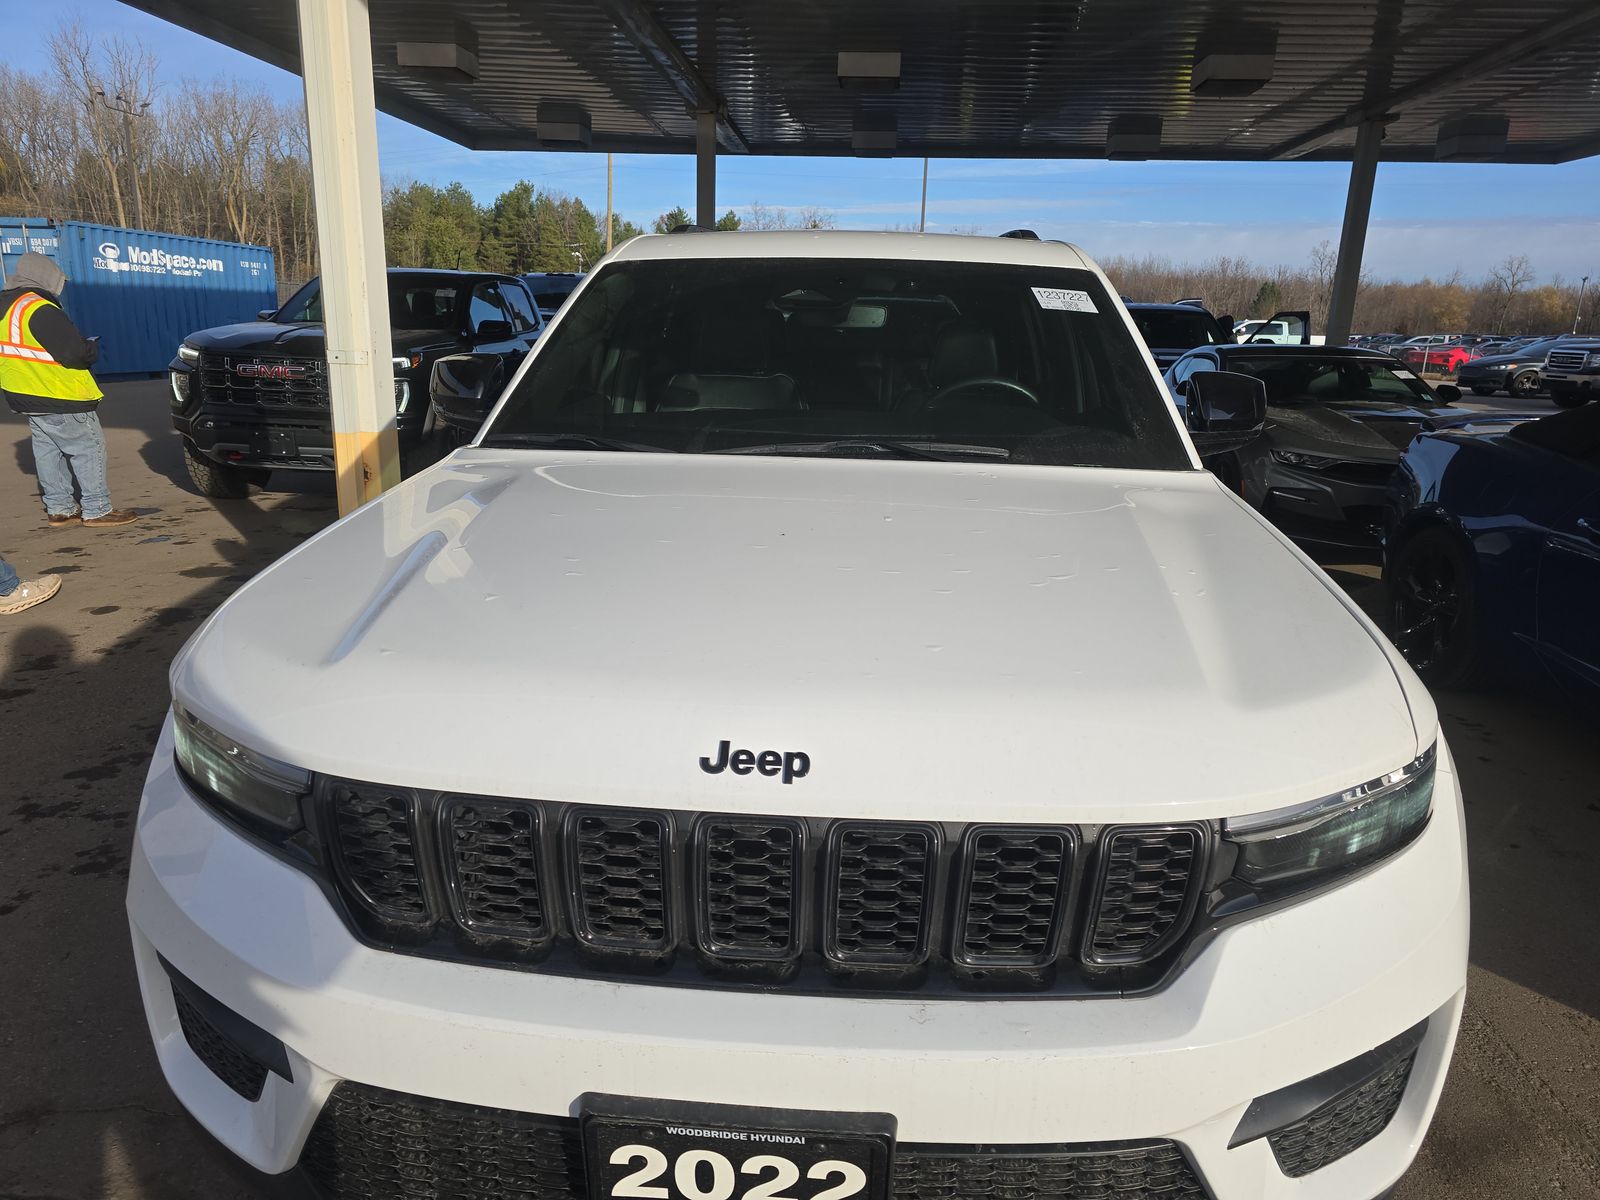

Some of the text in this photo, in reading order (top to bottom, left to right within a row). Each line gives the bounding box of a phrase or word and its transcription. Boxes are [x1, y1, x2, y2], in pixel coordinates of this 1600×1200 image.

[128, 246, 224, 273] ModSpace.com
[1037, 290, 1089, 302] 1237227
[236, 364, 305, 380] GMC
[698, 740, 811, 785] Jeep
[665, 1126, 806, 1145] WOODBRIDGE HYUNDAI
[609, 1144, 867, 1200] 2022
